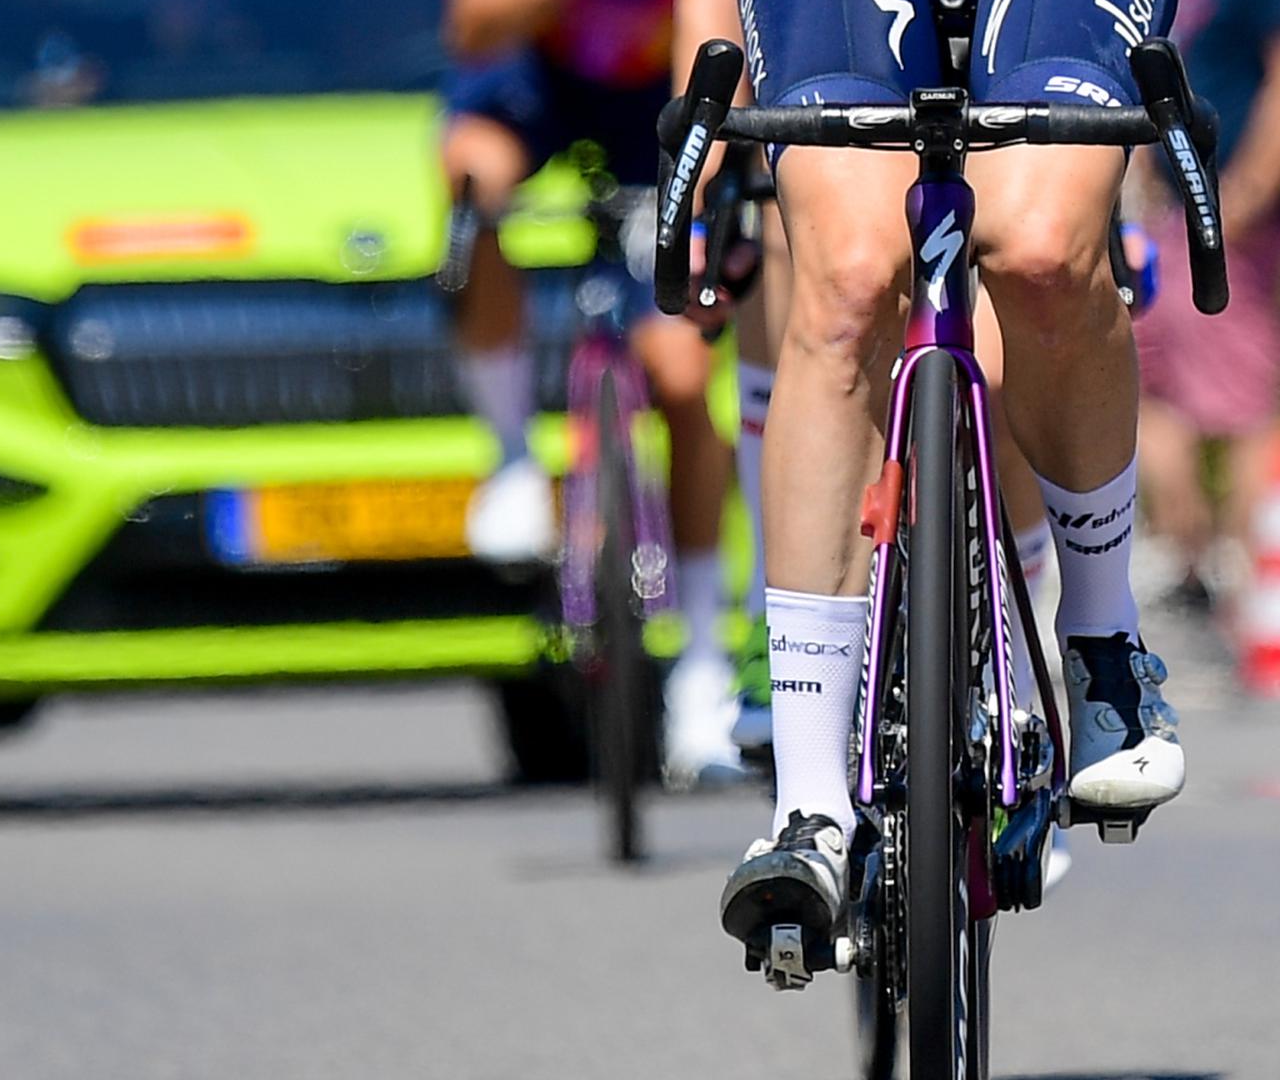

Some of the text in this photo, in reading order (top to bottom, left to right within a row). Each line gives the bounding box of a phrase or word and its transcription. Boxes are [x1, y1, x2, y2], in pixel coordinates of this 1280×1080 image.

[920, 92, 956, 101] GARMIN
[1044, 75, 1122, 107] SR
[663, 124, 708, 226] SRAM
[1167, 129, 1214, 226] SRAM
[771, 634, 850, 657] sdworx
